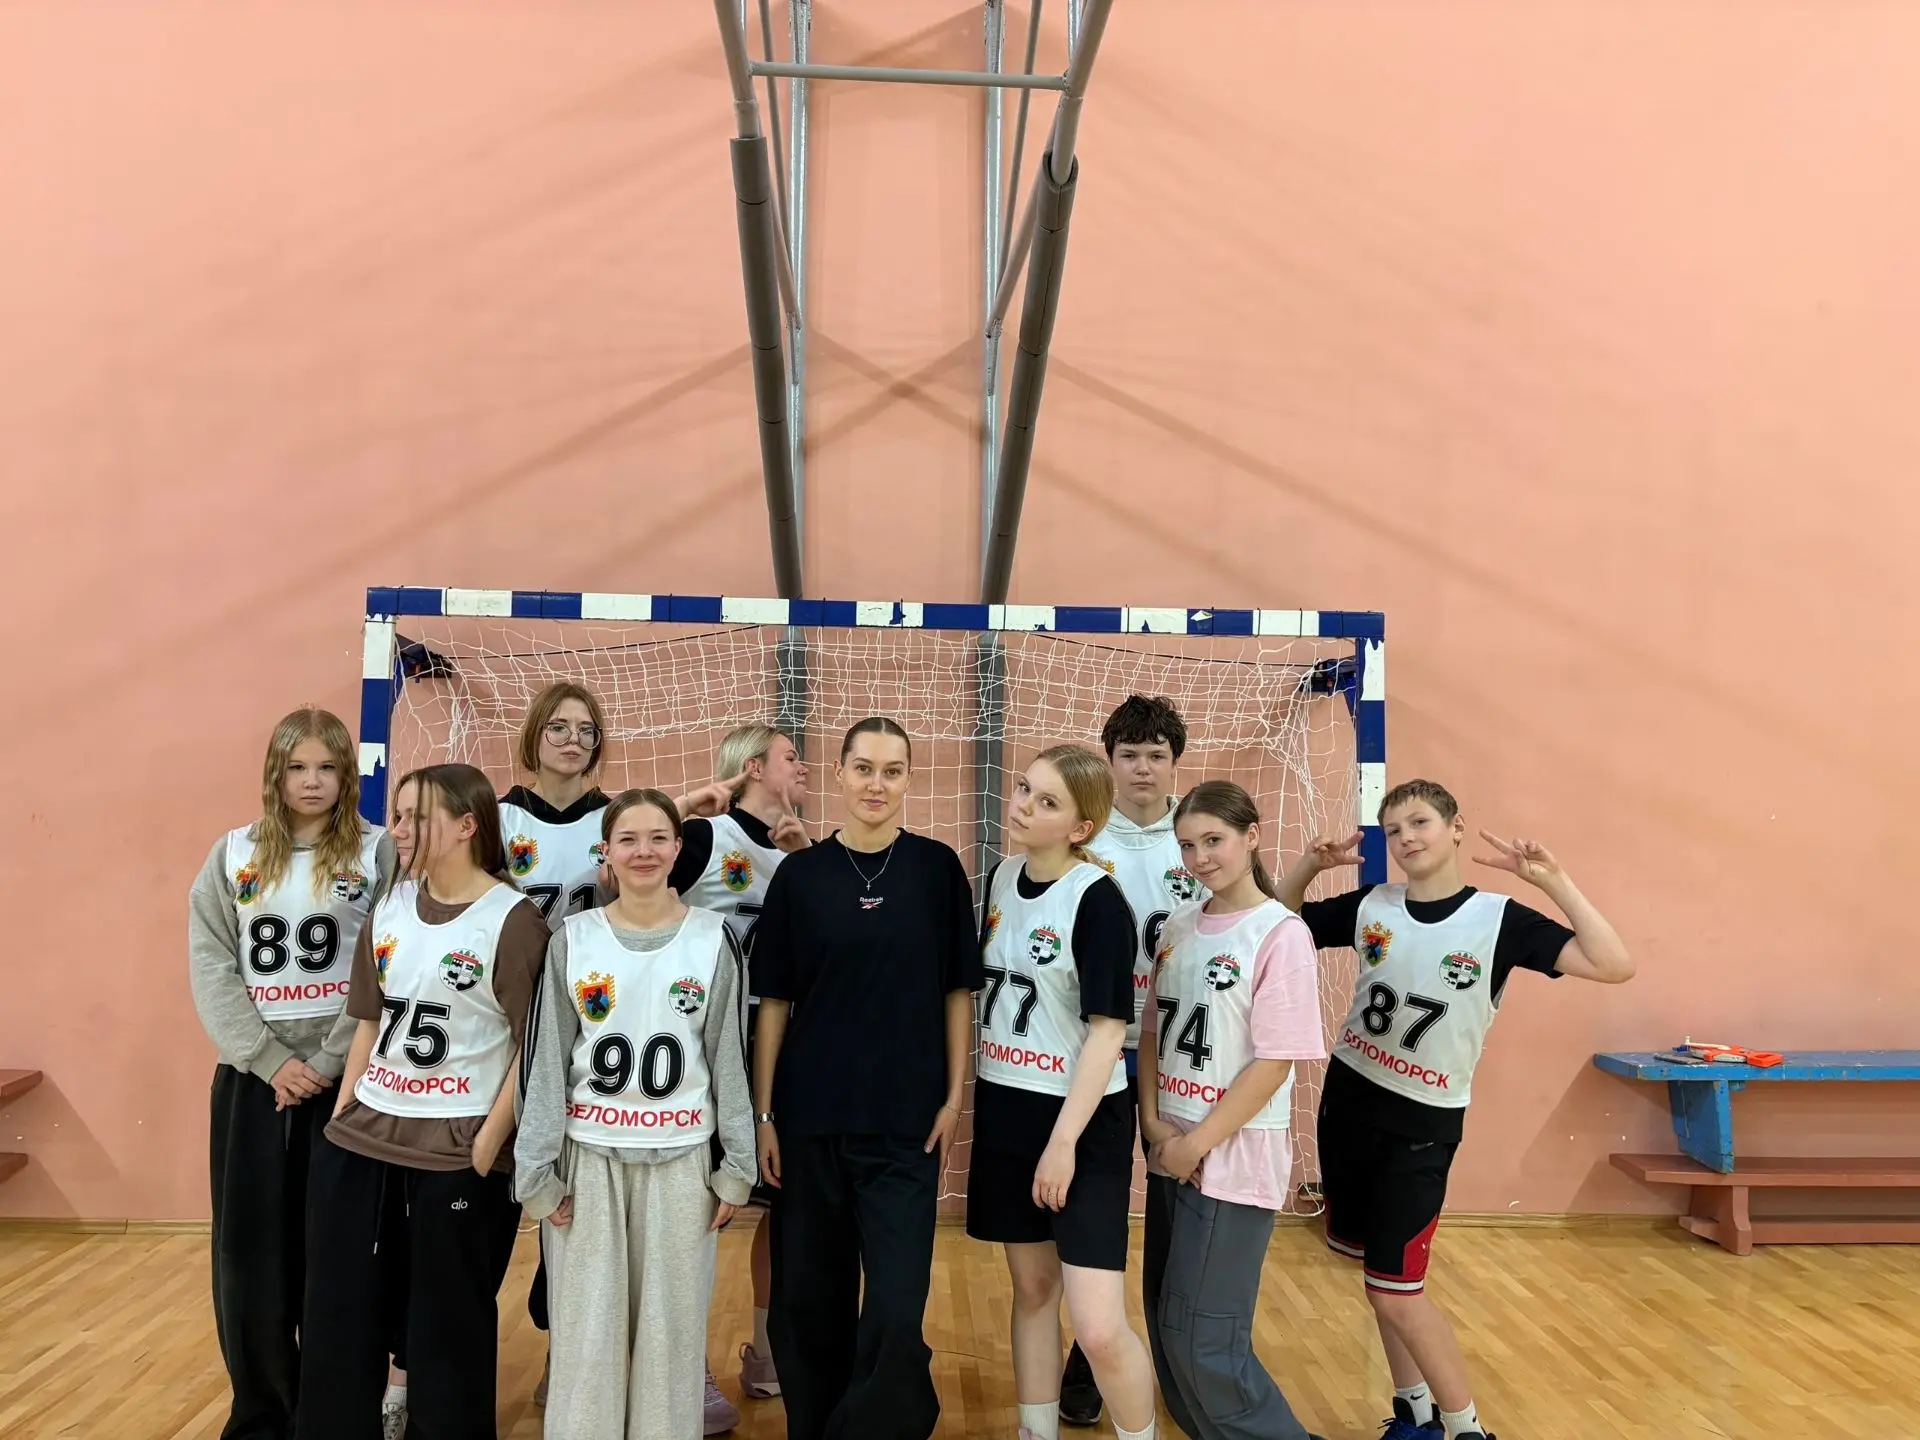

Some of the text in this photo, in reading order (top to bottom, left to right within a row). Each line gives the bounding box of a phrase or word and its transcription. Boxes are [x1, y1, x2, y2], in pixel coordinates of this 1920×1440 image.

[248, 913, 340, 976] 89
[375, 996, 451, 1069] 75
[980, 965, 1039, 1037] 77
[1156, 996, 1212, 1071] 74
[1360, 982, 1449, 1053] 87
[587, 1032, 686, 1100] 90
[1343, 1028, 1450, 1089] БЕЛОМОРСК
[451, 1197, 468, 1210] alo
